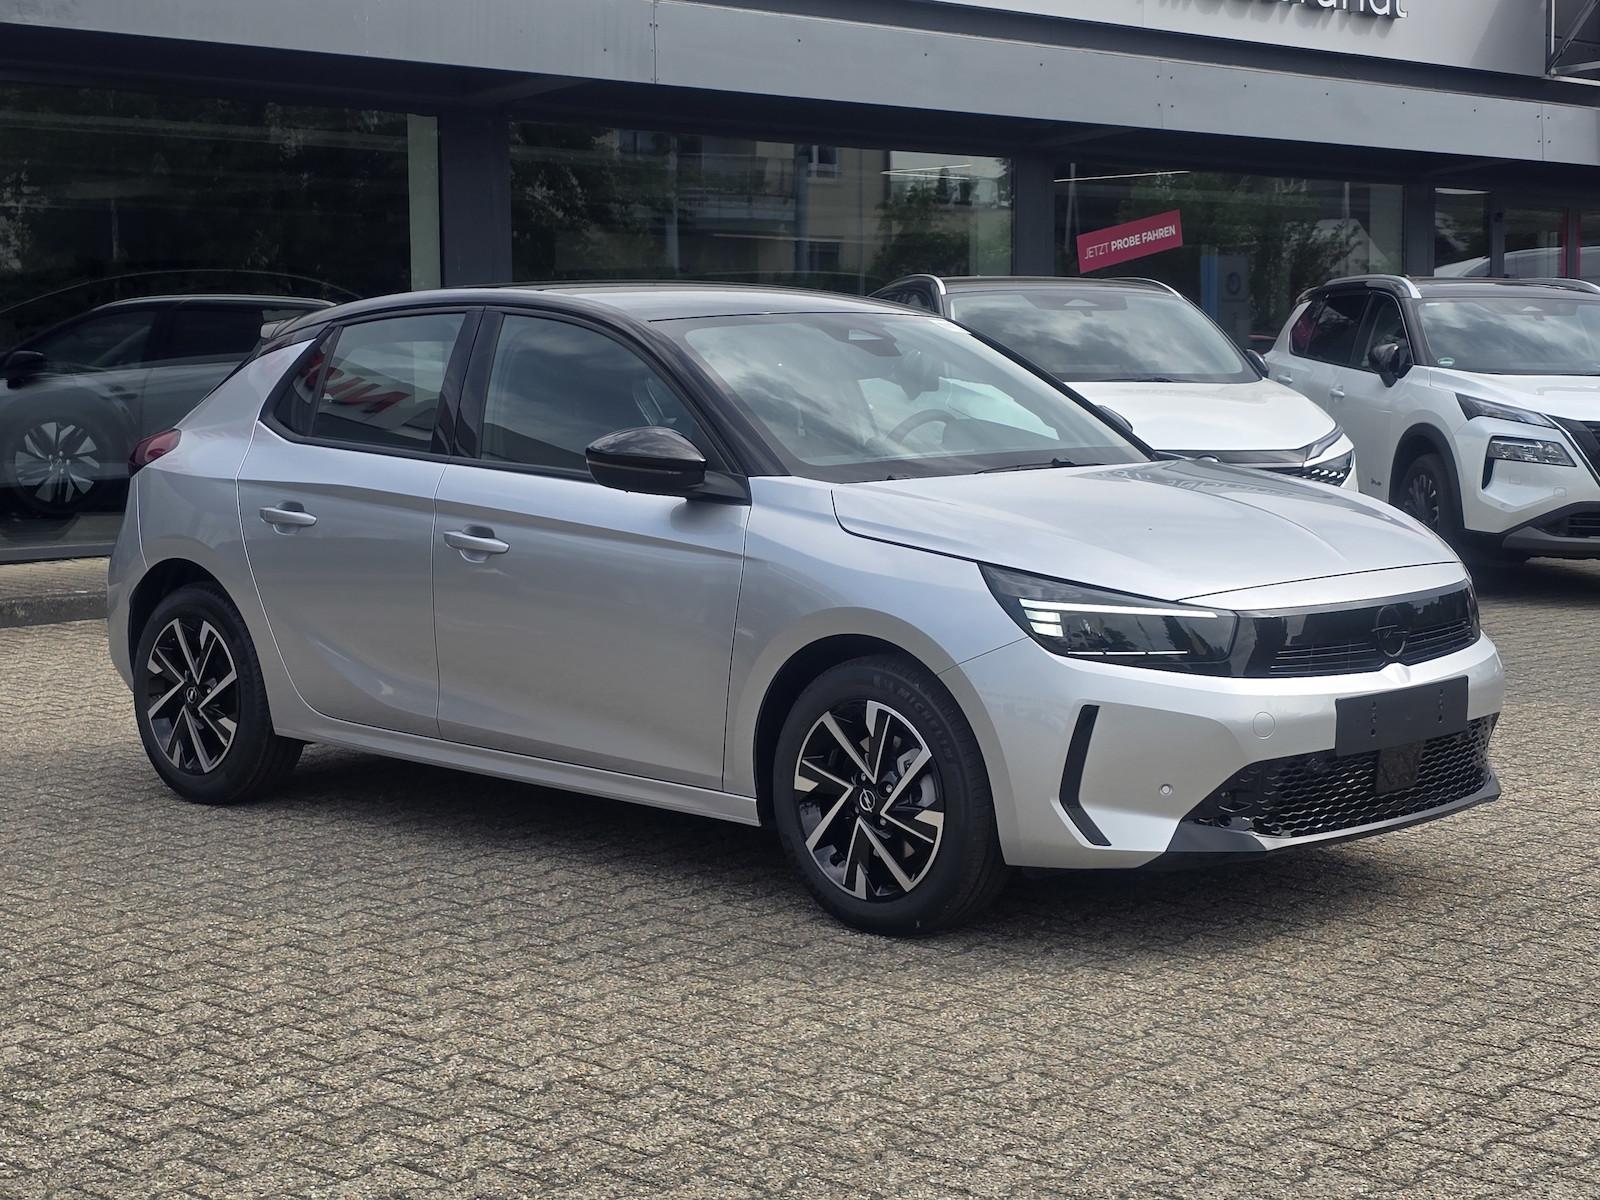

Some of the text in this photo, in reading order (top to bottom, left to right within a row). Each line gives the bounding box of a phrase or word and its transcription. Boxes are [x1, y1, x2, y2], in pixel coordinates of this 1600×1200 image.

[1084, 224, 1176, 260] JETZT PROBE FAHREN
